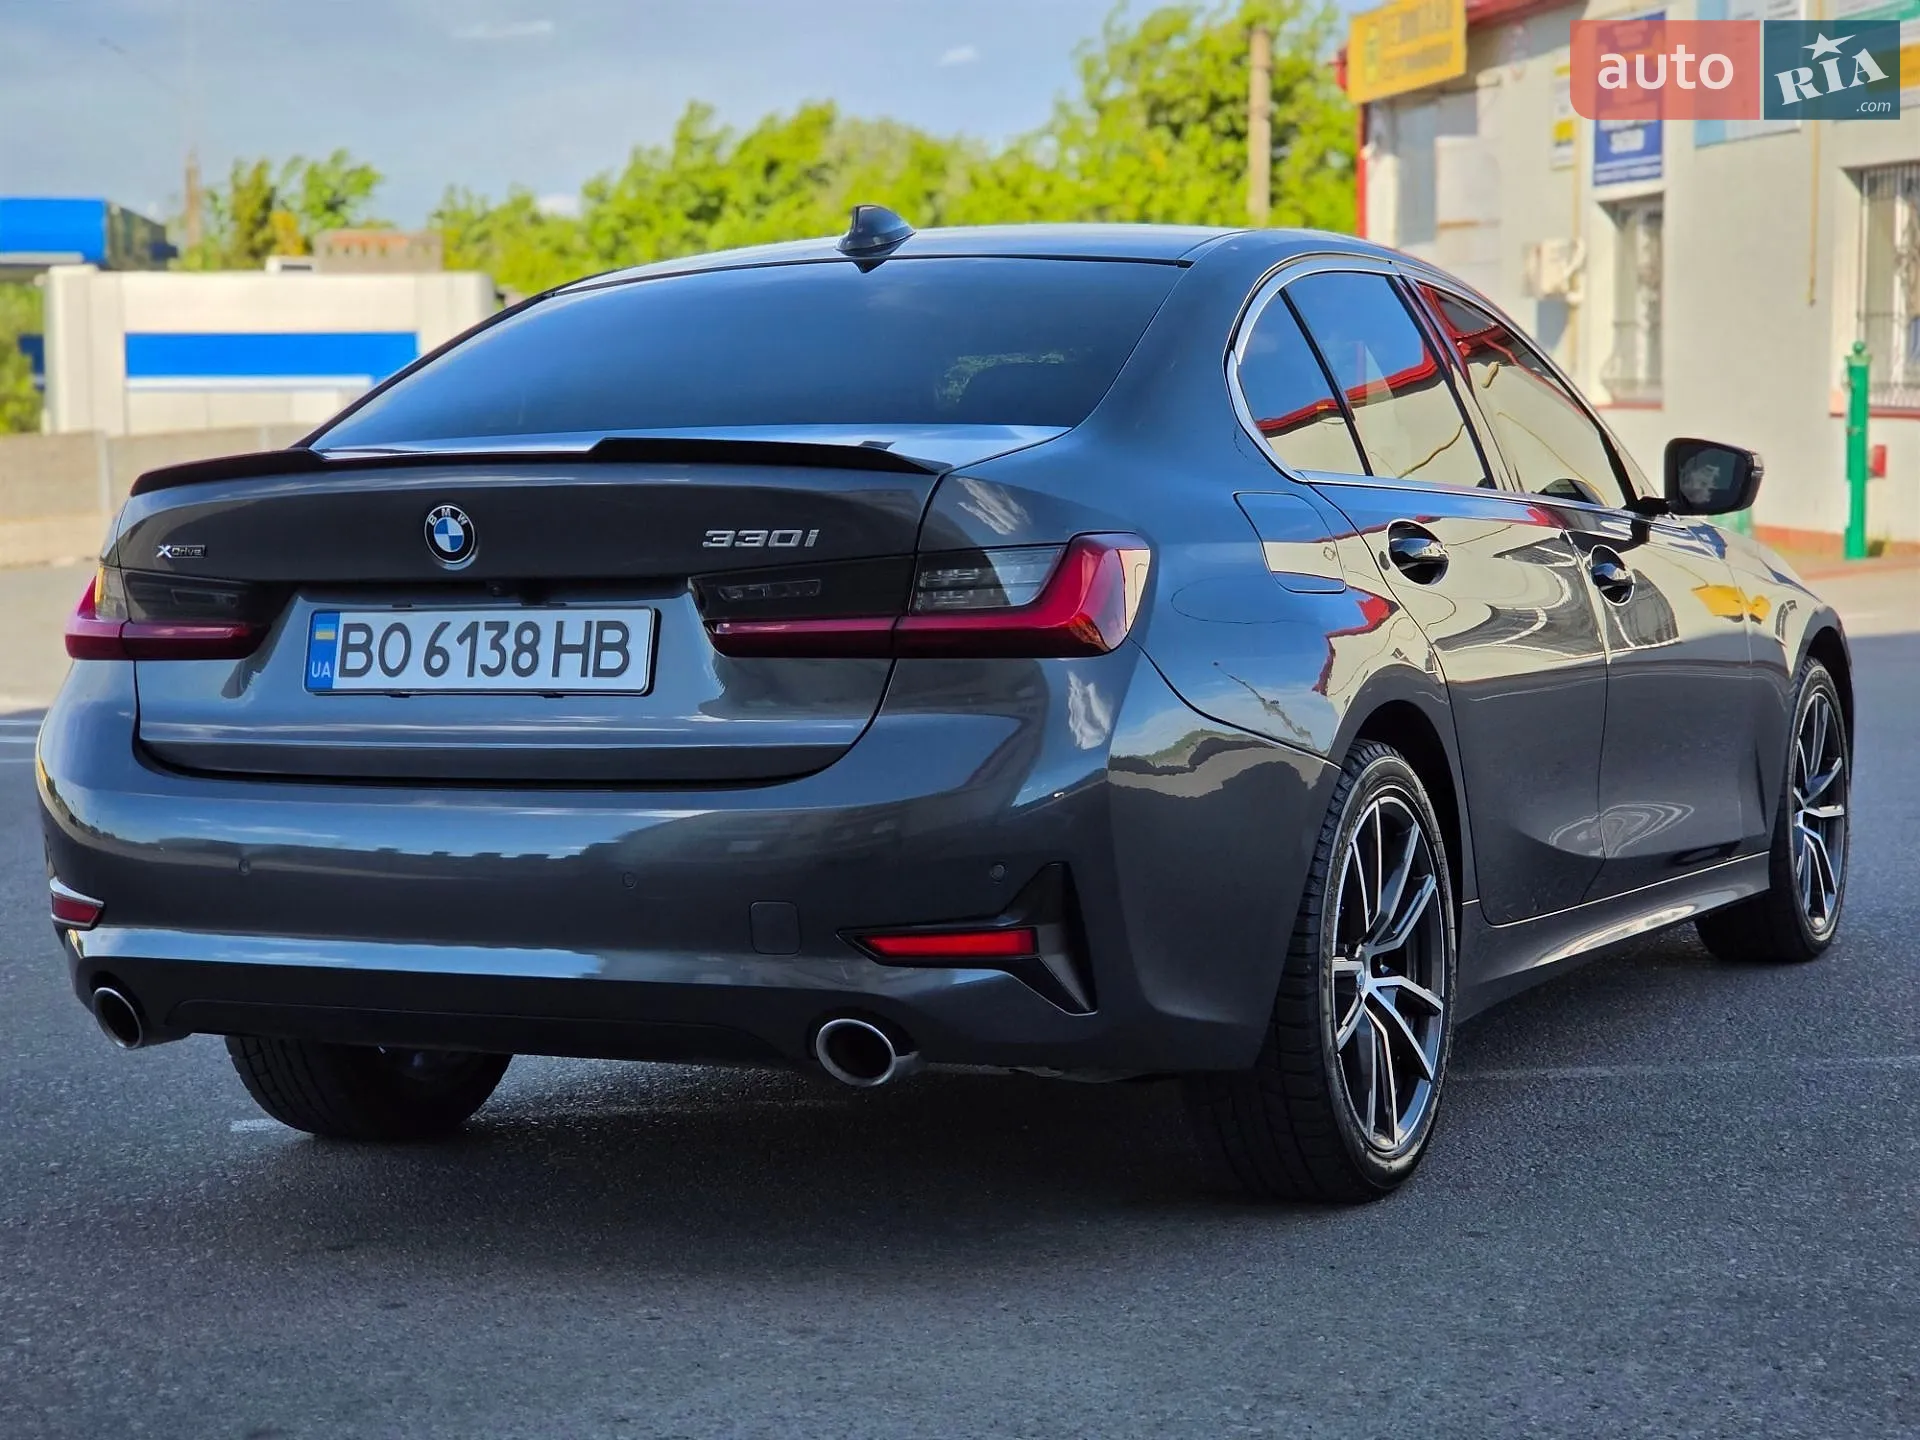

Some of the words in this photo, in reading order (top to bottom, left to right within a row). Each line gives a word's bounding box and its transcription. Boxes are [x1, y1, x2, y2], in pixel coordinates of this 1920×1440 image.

[427, 507, 468, 526] BMW
[702, 529, 819, 548] 330i
[338, 621, 411, 678] BO
[423, 620, 540, 678] 6138
[551, 619, 631, 678] HB
[311, 660, 332, 679] UA
